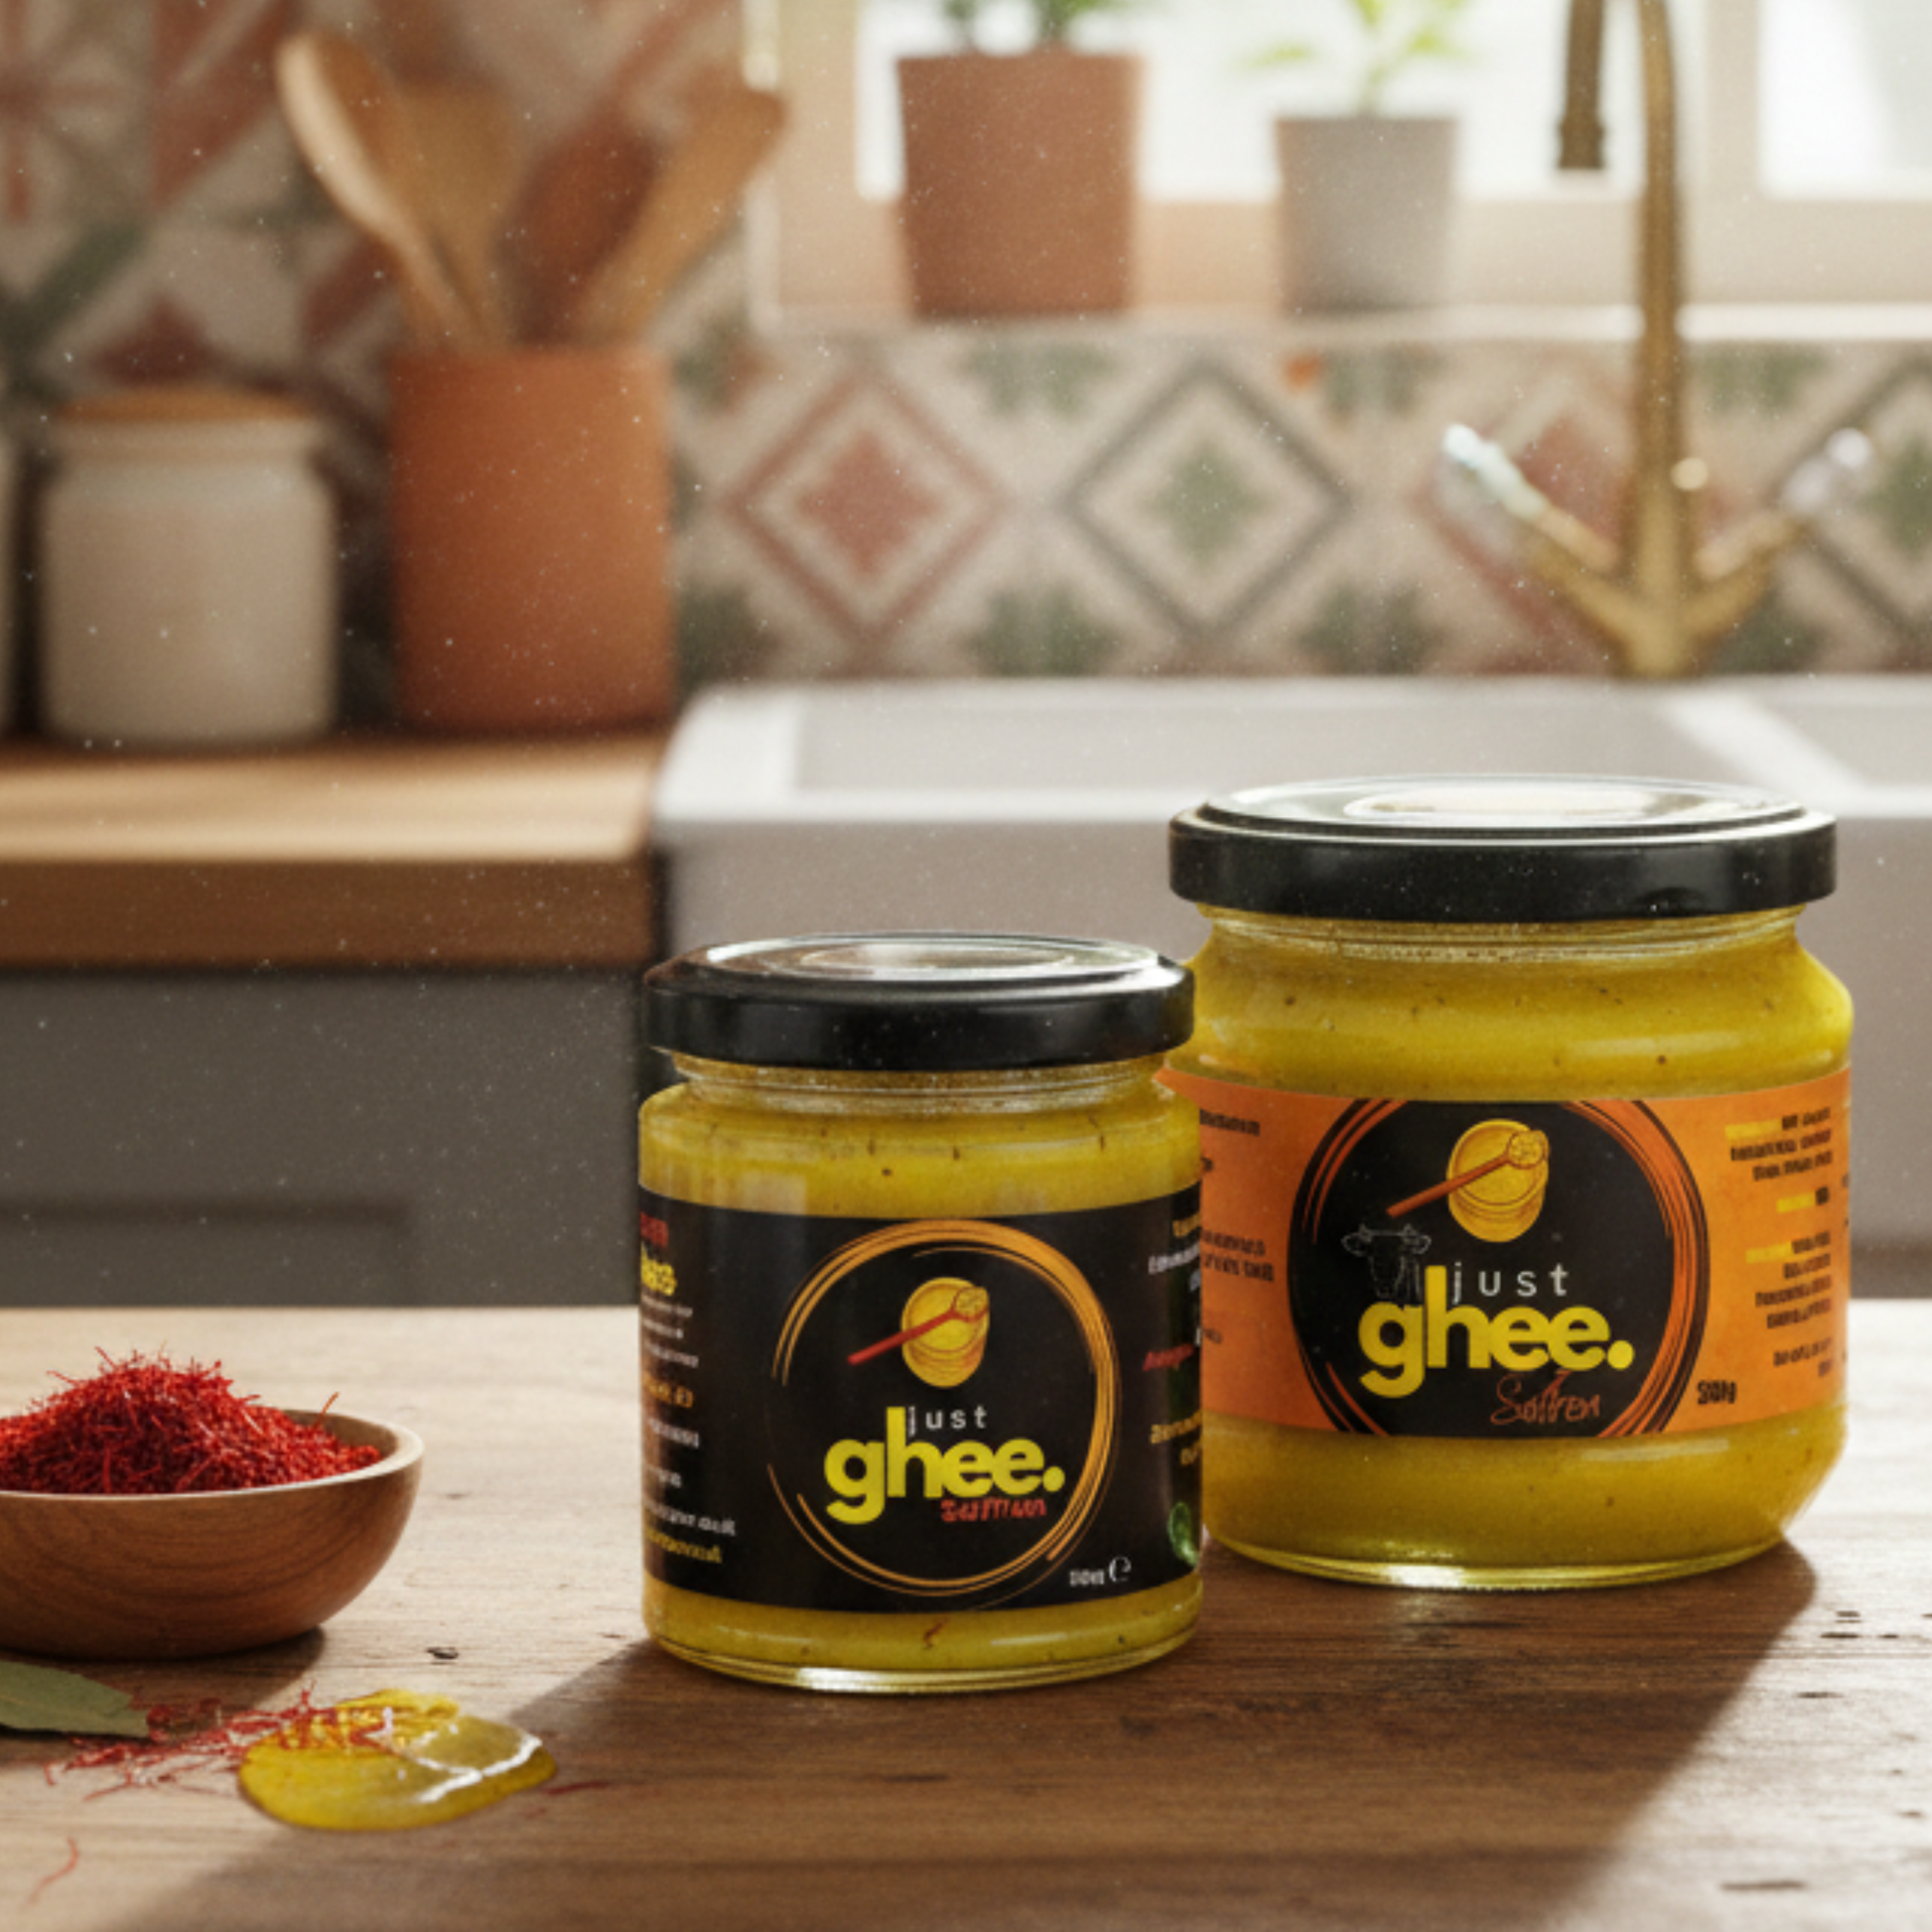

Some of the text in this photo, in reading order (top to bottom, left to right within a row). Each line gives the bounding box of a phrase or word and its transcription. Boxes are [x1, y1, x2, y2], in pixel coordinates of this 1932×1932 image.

[1452, 1262, 1569, 1305] just
[1358, 1265, 1635, 1399] ghee.
[907, 1406, 988, 1437] just
[824, 1406, 1065, 1525] ghee.
